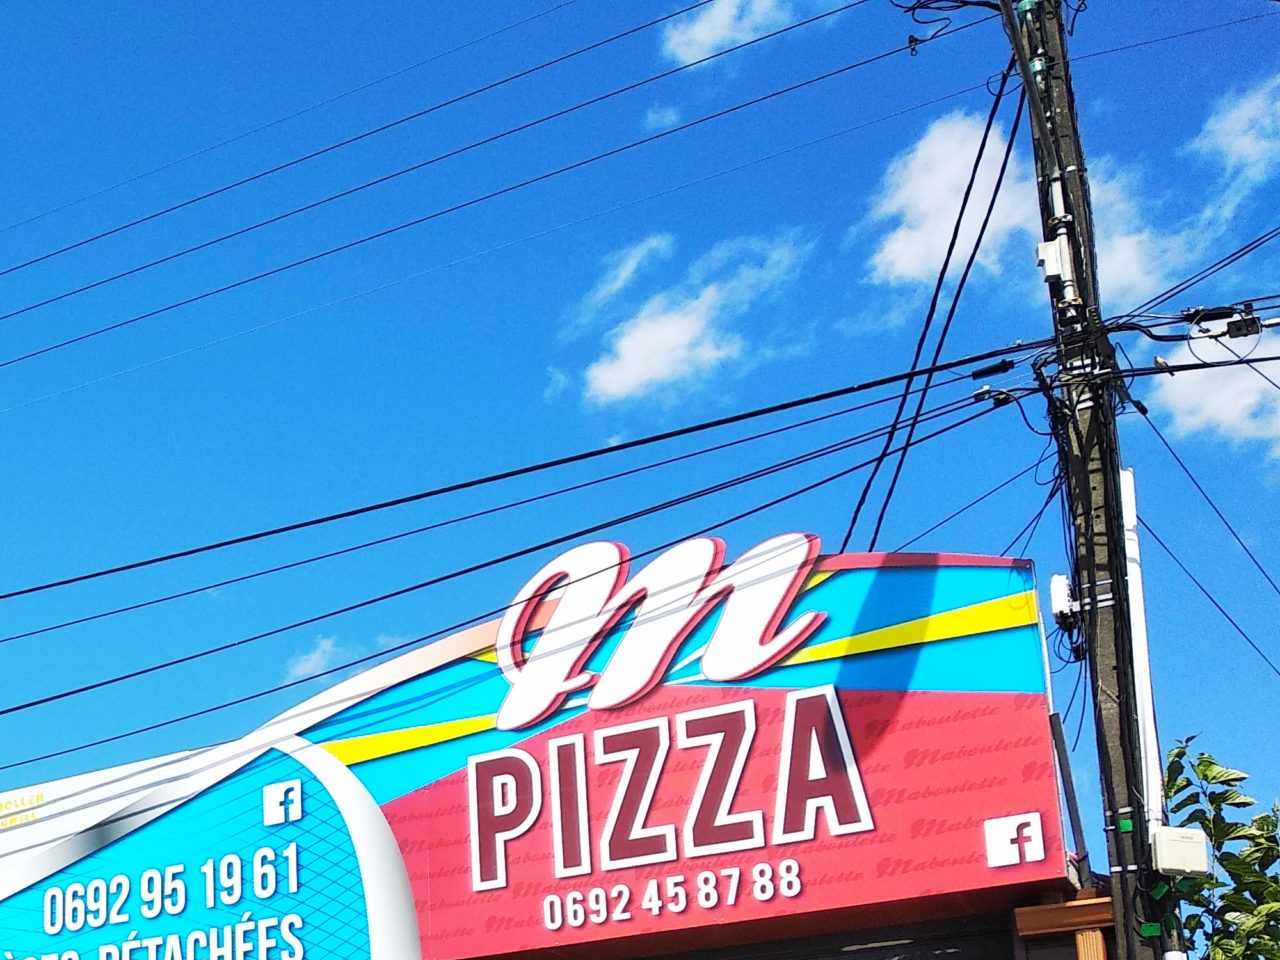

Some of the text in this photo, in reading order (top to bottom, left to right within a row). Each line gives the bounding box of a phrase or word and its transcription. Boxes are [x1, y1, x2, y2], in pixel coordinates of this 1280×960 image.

[904, 735, 1043, 769] Maboulette
[467, 684, 875, 892] PIZZA
[870, 775, 1008, 807] Maboulette
[0, 812, 38, 829] GRILL
[43, 841, 300, 936] 0692 95 19 61
[543, 883, 631, 931] 0692
[641, 873, 687, 916] 45
[697, 867, 741, 910] 87
[752, 858, 801, 902] 88
